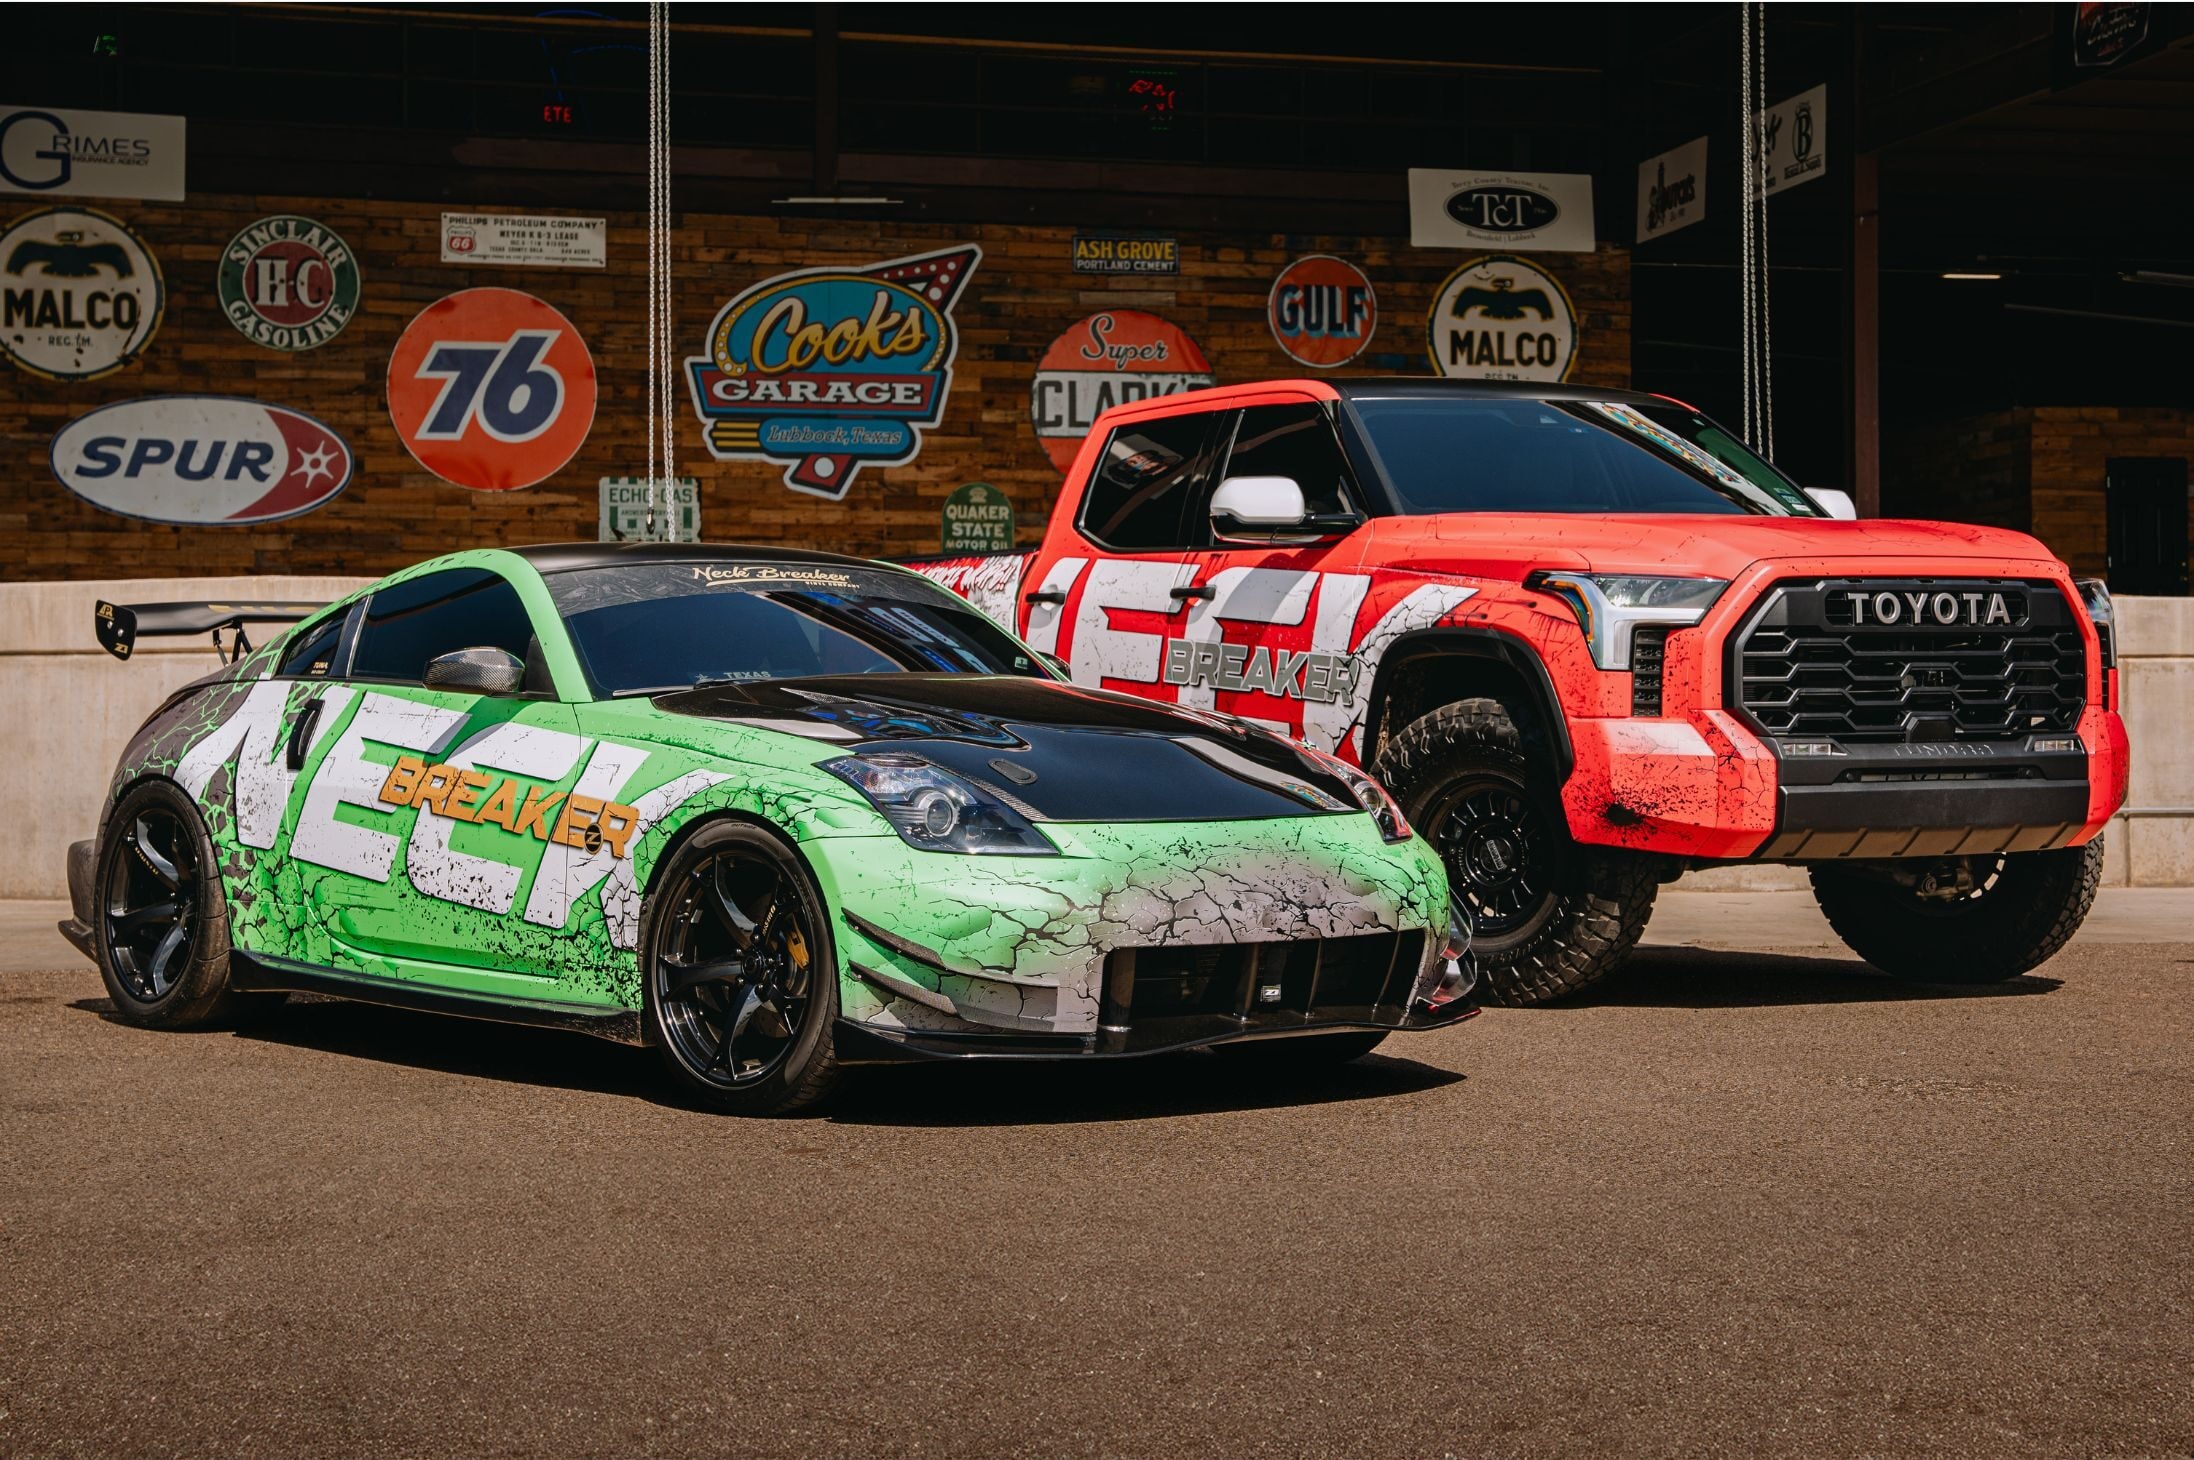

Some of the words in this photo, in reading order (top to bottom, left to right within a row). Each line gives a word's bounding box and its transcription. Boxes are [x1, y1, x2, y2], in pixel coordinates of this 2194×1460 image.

[449, 216, 488, 226] PHILLIPS
[493, 218, 547, 228] PETROLEUM
[551, 220, 597, 230] COMPANY
[229, 220, 347, 269] SINCLAIR
[1076, 240, 1113, 260] ASH
[1116, 241, 1175, 261] GROVE
[1076, 260, 1131, 270] PORTLAND
[1133, 261, 1175, 271] CEMENT
[4, 288, 137, 329] MALCO
[228, 299, 349, 348] GASOLINE
[1277, 284, 1371, 338] GULF
[751, 290, 928, 374] Cooks
[1081, 313, 1169, 371] Super
[1450, 330, 1556, 367] MALCO
[413, 328, 565, 443] 76
[712, 379, 922, 405] GARAGE
[1038, 380, 1214, 428] CLA'
[767, 425, 848, 445] Lubbock,
[851, 427, 902, 444] Texas
[74, 436, 274, 482] SPUR
[946, 504, 1009, 520] QUAKER
[951, 521, 1005, 538] STATE
[945, 539, 988, 551] MOTOR
[692, 566, 750, 581] Neck
[744, 567, 850, 581] Breaker
[1845, 592, 2012, 625] TOYOTA
[723, 668, 772, 679] TEXAS
[1163, 638, 1359, 705] BREAKER
[378, 757, 641, 859] BREAKER
